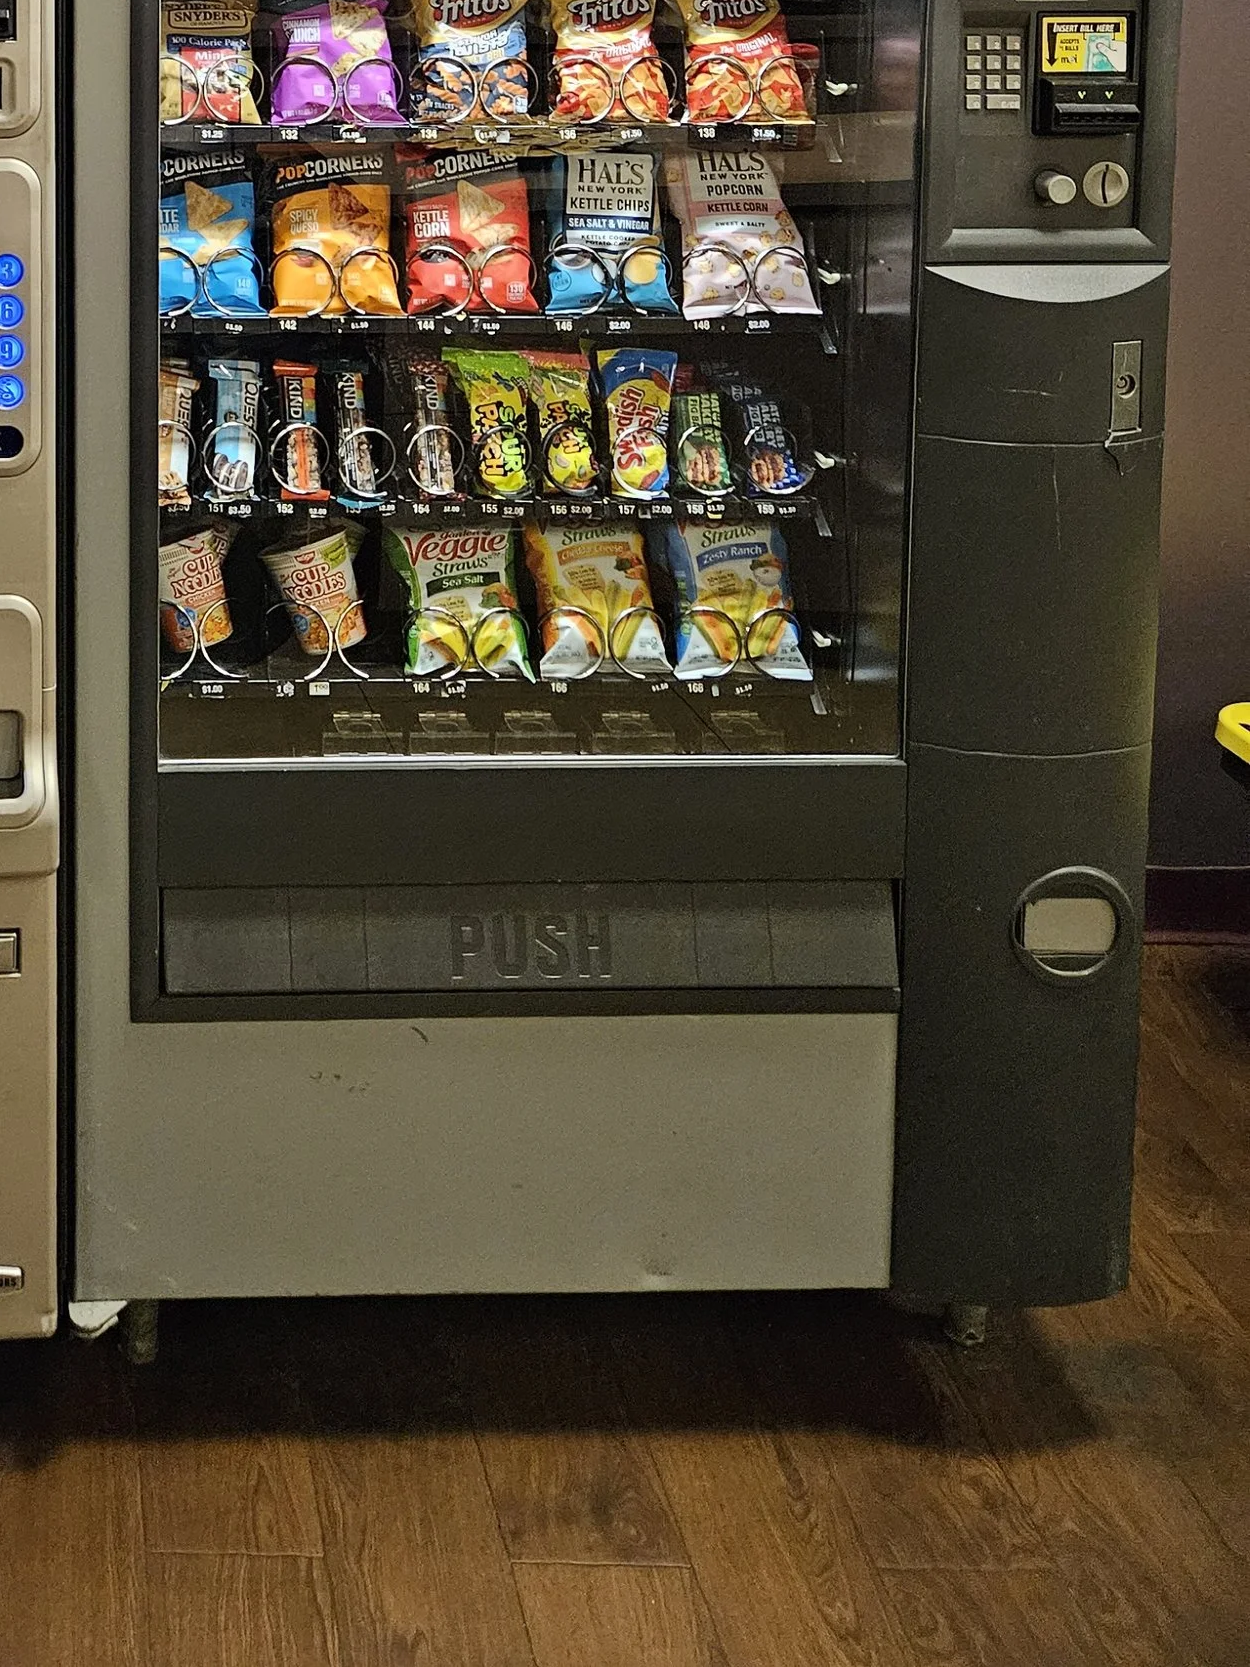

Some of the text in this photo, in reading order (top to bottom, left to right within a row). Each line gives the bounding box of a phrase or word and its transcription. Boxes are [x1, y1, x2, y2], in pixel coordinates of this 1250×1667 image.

[172, 11, 241, 23] SNYDER'S
[1053, 23, 1115, 33] INSERT BILL HERE
[720, 32, 778, 54] The ORIGINAL
[280, 129, 299, 140] 132
[276, 154, 384, 184] POPCORNERS
[699, 151, 766, 173] HAL'S
[578, 158, 645, 186] HAL'S
[700, 172, 766, 181] NEW YORK
[578, 185, 643, 195] NEW YORK
[706, 184, 764, 197] POPCORN
[570, 196, 650, 212] KETTLE CHIPS
[707, 201, 769, 214] KETTLE CORN
[289, 209, 319, 223] SPICY
[413, 210, 449, 223] KETTLE
[568, 217, 650, 231] SEA SALT & VINEGAR
[290, 221, 319, 234] QUESO
[414, 222, 450, 238] CORN
[1, 261, 13, 281] 3
[1, 301, 13, 322] 6
[279, 319, 297, 331] 142
[1, 340, 13, 361] 9
[288, 379, 303, 420] KIND
[570, 505, 593, 514] $2.00
[700, 526, 758, 549] Straws
[403, 533, 510, 567] Veggie
[702, 544, 764, 565] Zesty Ranch
[181, 554, 217, 578] CUP
[291, 562, 331, 585] CUP
[432, 558, 488, 578] Straws
[283, 572, 347, 603] NOODLES
[442, 574, 485, 588] Sea Salt
[202, 684, 223, 694] $1.00
[450, 913, 613, 980] PUSH
